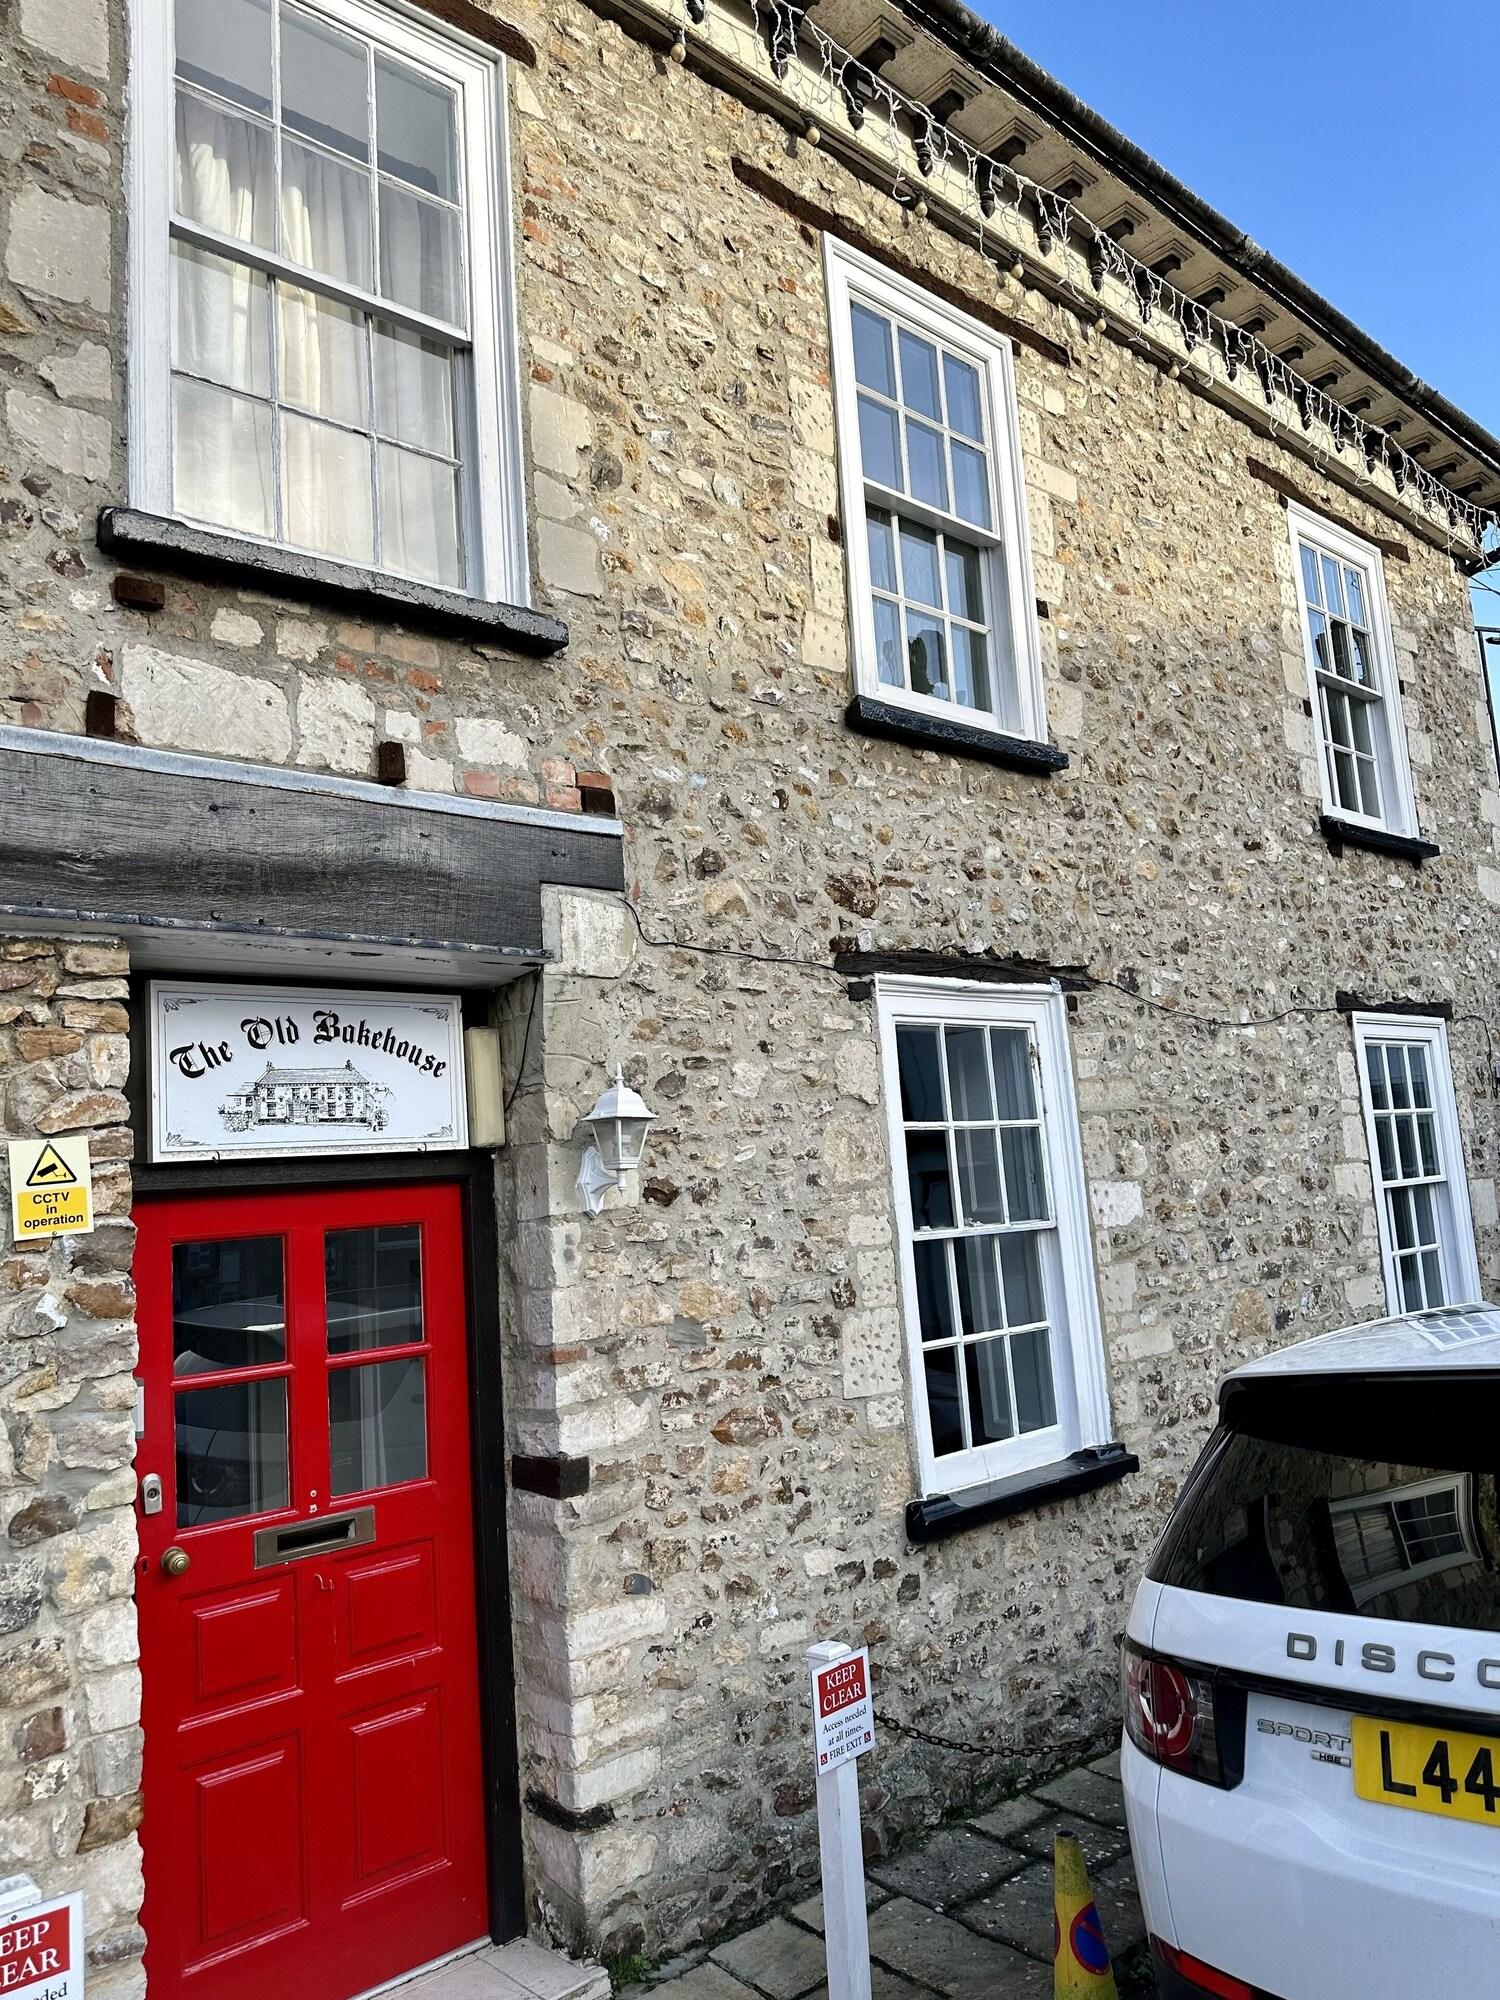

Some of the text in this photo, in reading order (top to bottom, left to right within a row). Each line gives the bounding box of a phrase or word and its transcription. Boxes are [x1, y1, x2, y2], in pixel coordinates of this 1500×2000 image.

[169, 1010, 447, 1079] The Old Bakehouse
[32, 1191, 70, 1205] CCTV
[46, 1204, 57, 1214] in
[24, 1214, 84, 1229] operation
[825, 1663, 857, 1690] KEEP
[823, 1681, 863, 1712] CLEAR
[823, 1704, 867, 1735] Access needed
[828, 1737, 835, 1747] at
[835, 1730, 844, 1743] all
[829, 1736, 863, 1760] FIRE EXIT
[1257, 1718, 1351, 1753] SPORT
[0, 1948, 61, 1988] EAR
